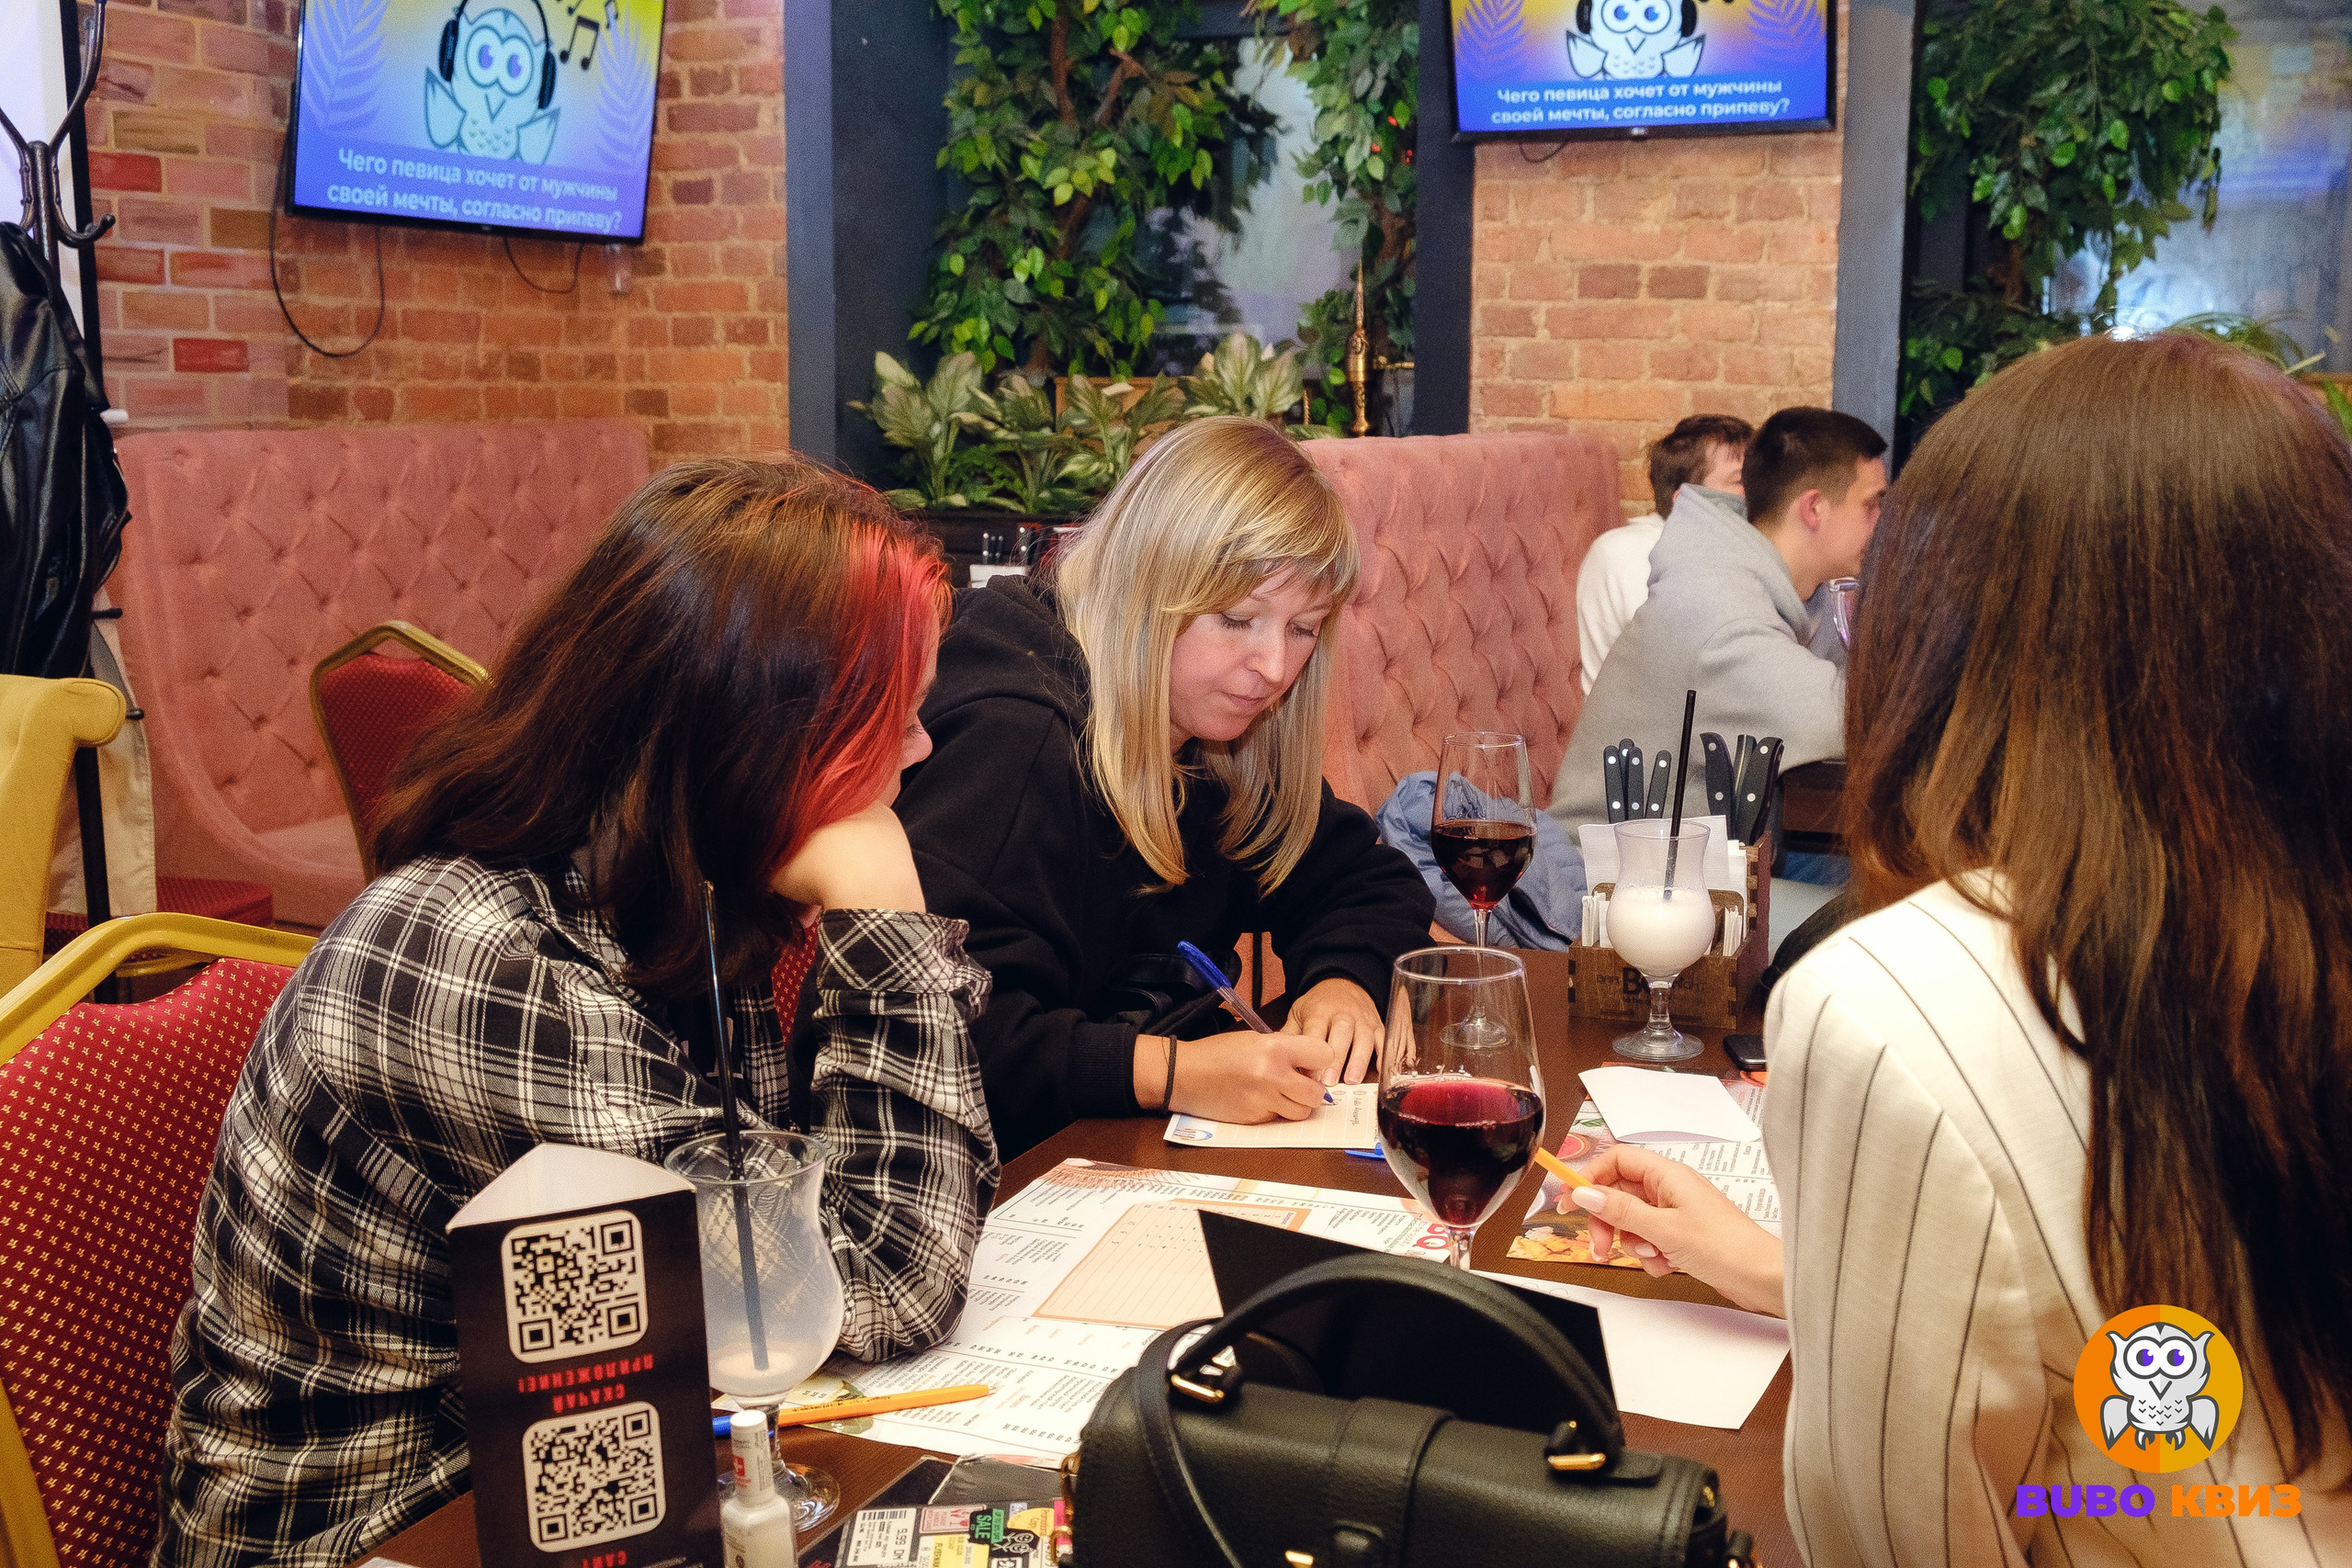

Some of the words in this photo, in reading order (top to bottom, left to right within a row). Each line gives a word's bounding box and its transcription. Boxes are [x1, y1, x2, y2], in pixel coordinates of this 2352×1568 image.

[1498, 88, 1540, 104] Чего
[1544, 85, 1610, 103] певица
[1613, 84, 1664, 99] хочет
[1668, 84, 1689, 97] от
[1693, 80, 1782, 99] мужчины
[1491, 106, 1544, 125] своей
[1548, 106, 1610, 122] мечты,
[1613, 103, 1697, 119] согласно
[1701, 96, 1791, 118] припеву?
[338, 147, 388, 175] Чего
[391, 158, 462, 186] певица
[465, 167, 515, 189] хочет
[518, 175, 539, 192] от
[541, 177, 619, 202] мужчины
[326, 184, 389, 208] своей
[392, 190, 458, 218] мечты,
[461, 199, 543, 223] согласно
[545, 207, 623, 234] припеву?
[518, 1353, 653, 1393] ПРИЛОЖЕНИЕ!
[552, 1382, 625, 1413] СКАЧАЙ
[975, 1515, 992, 1540] SALE
